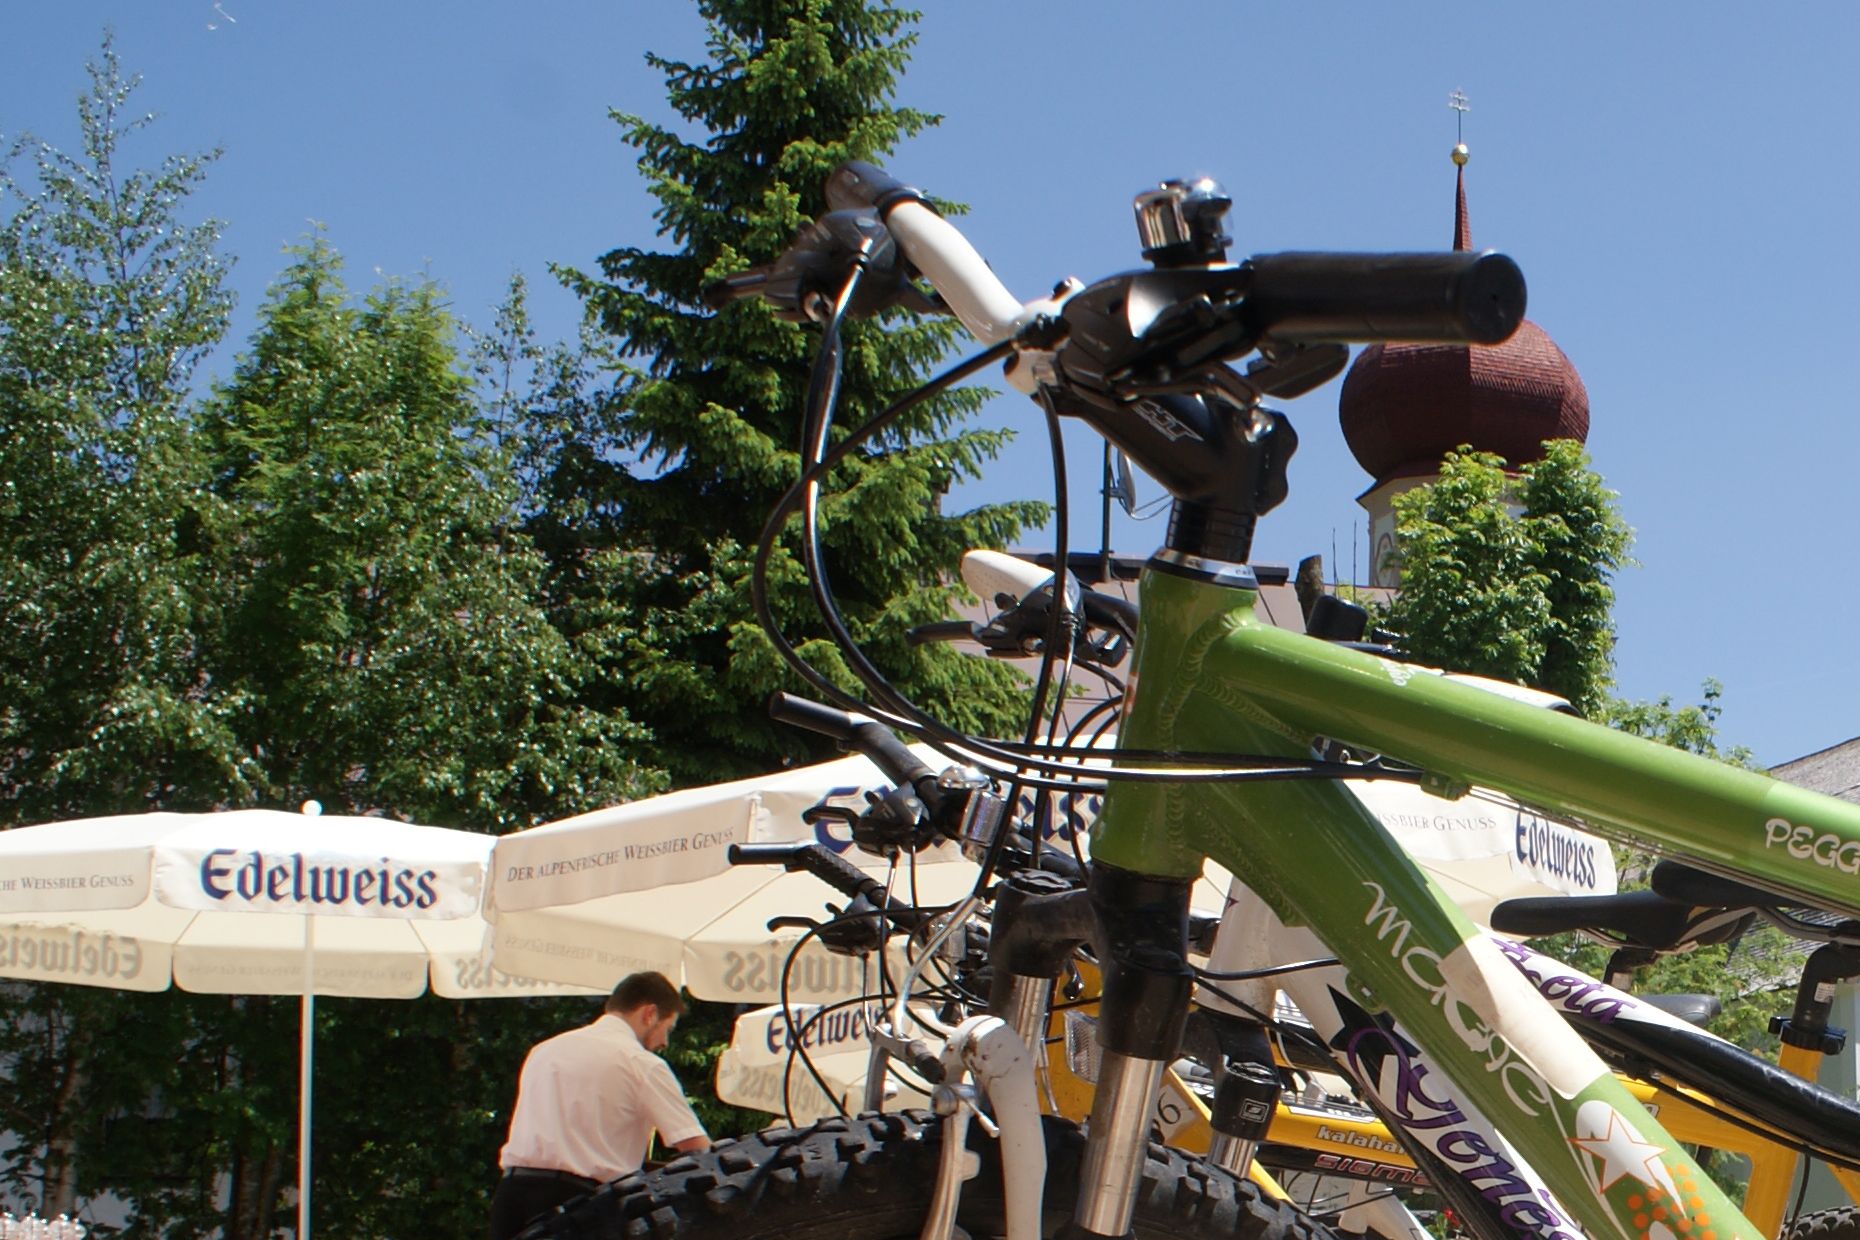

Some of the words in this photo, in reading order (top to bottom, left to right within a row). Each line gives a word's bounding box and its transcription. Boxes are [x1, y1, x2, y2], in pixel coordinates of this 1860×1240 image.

[1433, 815, 1497, 832] GENUSS
[1516, 810, 1596, 890] Edelweiss
[21, 876, 86, 890] WEISSBIER
[89, 874, 135, 889] GENUSS
[200, 848, 438, 909] Edelweiss
[507, 865, 534, 882] DER
[624, 841, 688, 861] WEISSBIER
[691, 828, 734, 850] GENUSS
